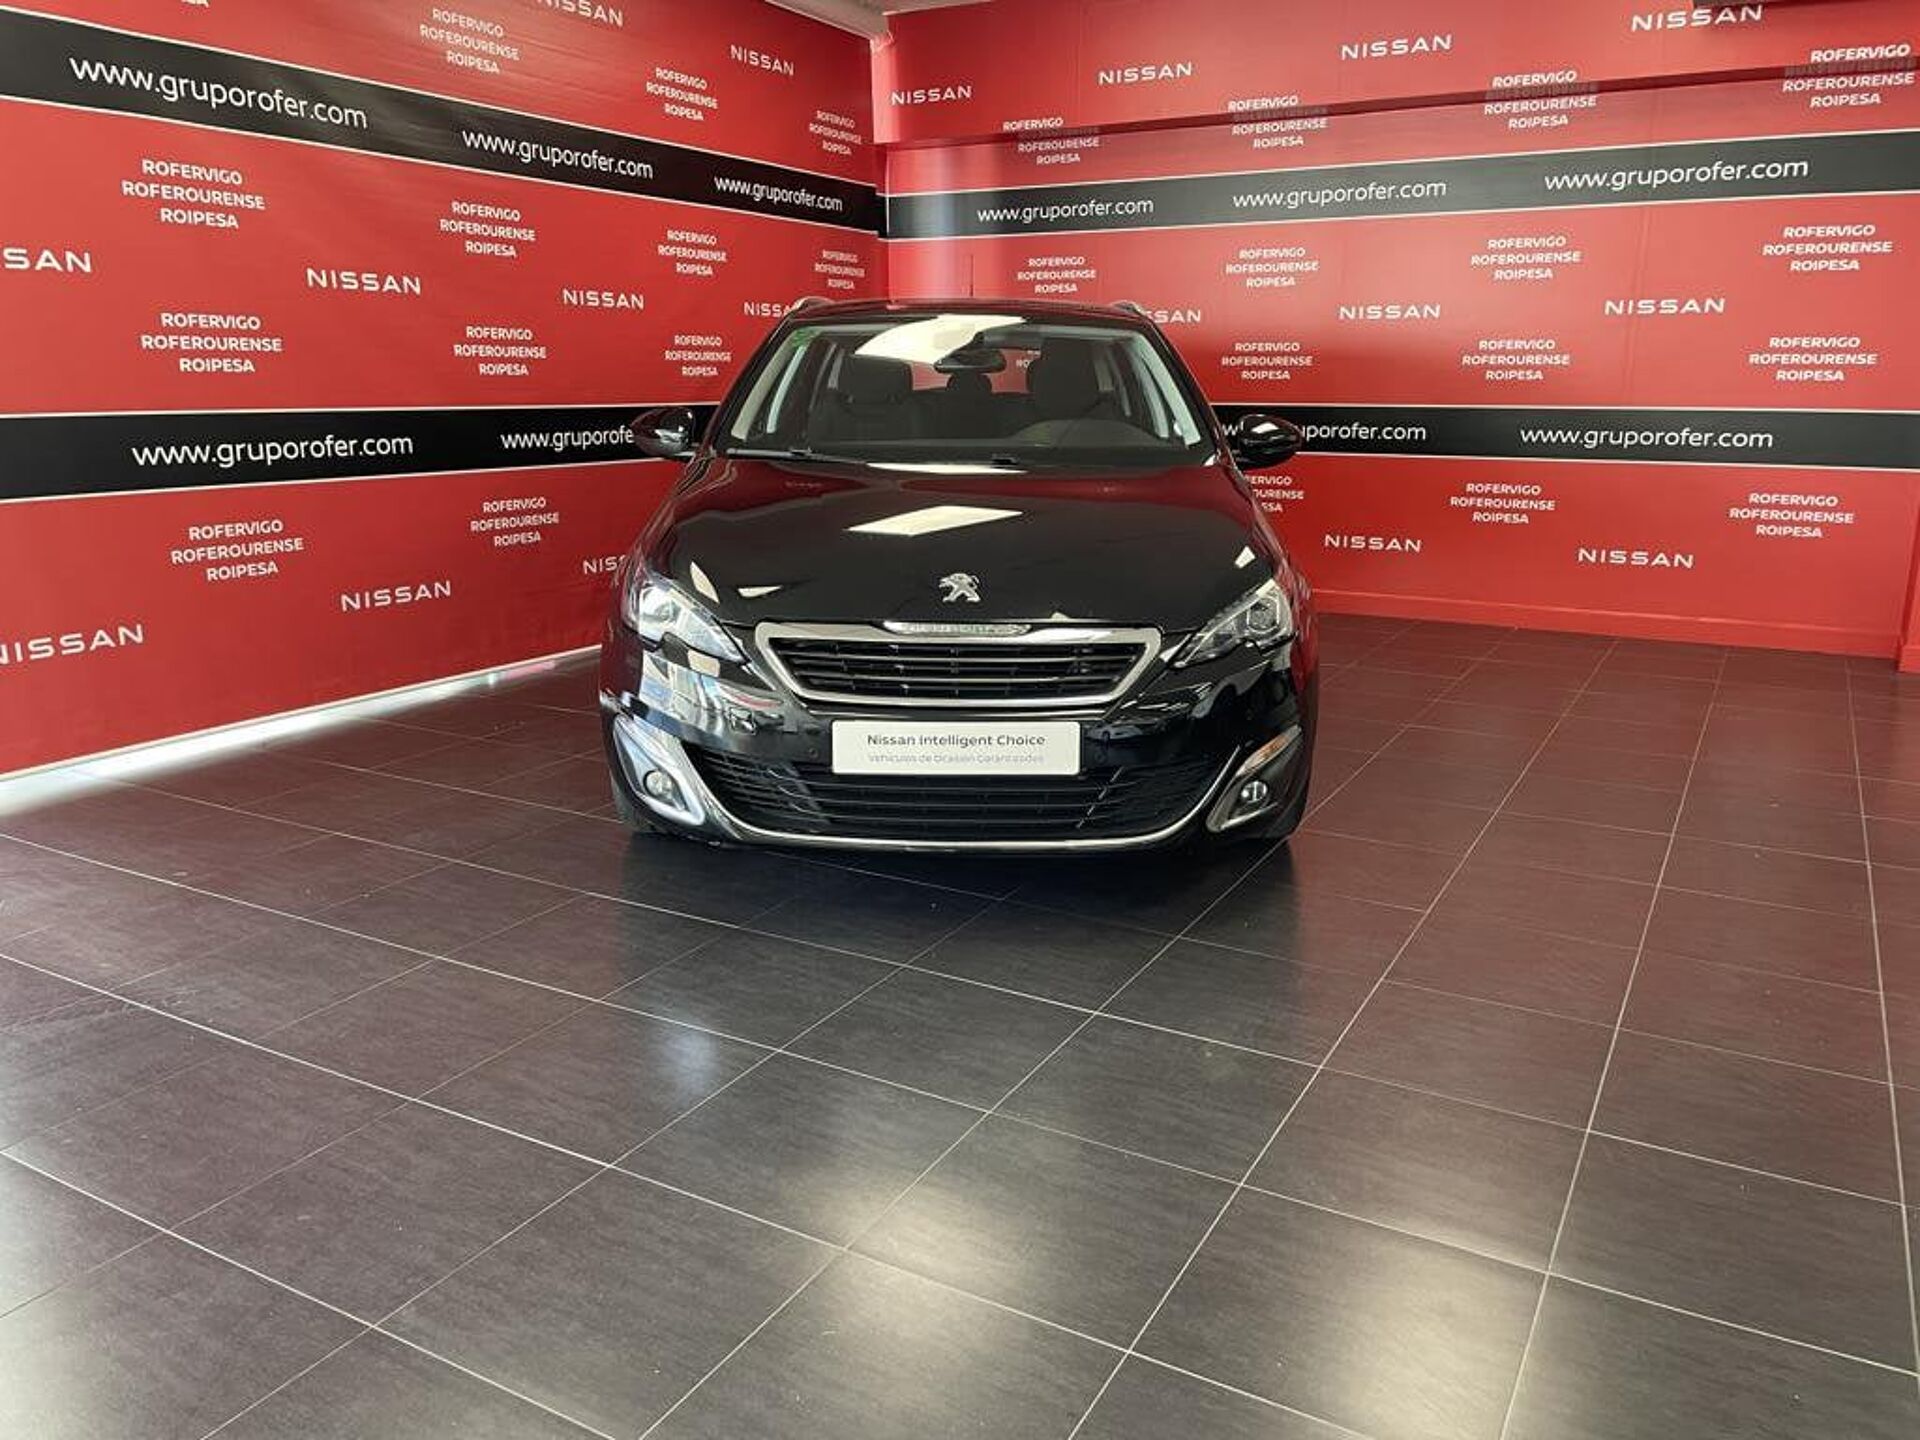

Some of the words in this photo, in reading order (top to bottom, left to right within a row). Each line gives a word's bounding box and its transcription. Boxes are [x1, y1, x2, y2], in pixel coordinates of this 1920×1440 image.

[433, 9, 503, 37] ROFERVIGO
[1631, 6, 1761, 32] NISSAN
[420, 24, 519, 60] ROFEROURENSE
[1342, 35, 1451, 60] NISSAN
[731, 45, 793, 75] NISSAN
[1811, 44, 1910, 62] ROFERVIGO
[447, 50, 499, 73] ROIPESA
[1100, 62, 1192, 84] NISSAN
[1493, 71, 1577, 88] ROFERVIGO
[1783, 72, 1914, 92] ROFEROURENSE
[70, 58, 367, 128] www.gruporofer.com
[891, 86, 971, 106] NISSAN
[1810, 93, 1880, 107] ROIPESA
[1228, 95, 1298, 112] ROFERVIGO
[1483, 95, 1598, 114] ROFEROURENSE
[1003, 117, 1063, 131] ROFERVIGO
[1232, 118, 1328, 135] ROFEROURENSE
[1509, 115, 1568, 128] ROIPESA
[1253, 136, 1303, 148] ROIPESA
[463, 130, 653, 179] www.gruporofer.com
[1037, 153, 1080, 164] ROIPESA
[142, 160, 242, 185] ROFERVIGO
[1544, 159, 1808, 191] www.gruporofer.com
[122, 180, 264, 209] ROFEROURENSE
[714, 176, 843, 211] www.gruporofer.com
[1233, 178, 1447, 210] www.gruporofer.com
[161, 208, 238, 228] ROIPESA
[452, 202, 520, 221] ROFERVIGO
[977, 198, 1154, 225] www.gruporofer.com
[440, 219, 535, 241] ROFEROURENSE
[1784, 225, 1875, 238] ROFERVIGO
[466, 241, 516, 257] ROIPESA
[1488, 236, 1566, 249] ROFERVIGO
[1763, 242, 1892, 255] ROFEROURENSE
[3, 247, 91, 273] SAN
[1240, 247, 1305, 259] ROFERVIGO
[1471, 251, 1580, 265] ROFEROURENSE
[1028, 257, 1085, 266] ROFERVIGO
[1226, 261, 1318, 273] ROFEROURENSE
[1791, 259, 1859, 271] ROIPESA
[307, 268, 420, 294] NISSAN
[1247, 276, 1295, 287] ROIPESA
[1494, 268, 1552, 280] ROIPESA
[1035, 283, 1077, 293] ROIPESA
[563, 289, 643, 309] NISSAN
[1605, 299, 1724, 314] NISSAN
[1340, 305, 1440, 319] NISSAN
[161, 313, 260, 330] ROFERVIGO
[466, 326, 532, 340] ROFERVIGO
[141, 335, 281, 351] ROFEROURENSE
[1235, 342, 1300, 351] ROFERVIGO
[1479, 339, 1555, 350] ROFERVIGO
[1770, 337, 1860, 348] ROFERVIGO
[454, 344, 546, 358] ROFEROURENSE
[1749, 354, 1877, 364] ROFEROURENSE
[180, 358, 255, 372] ROIPESA
[1222, 356, 1312, 366] ROFEROURENSE
[1463, 354, 1569, 365] ROFEROURENSE
[479, 364, 528, 375] ROIPESA
[1242, 370, 1290, 379] ROIPESA
[1486, 369, 1543, 380] ROIPESA
[1776, 370, 1844, 381] ROIPESA
[501, 425, 635, 452] www.gruporofe
[1520, 427, 1773, 449] www.gruporofer.com
[132, 434, 413, 468] www.gruporofer.com
[1466, 483, 1541, 495] ROFERVIGO
[483, 497, 546, 512] ROFERVIGO
[1451, 497, 1555, 510] ROFEROURENSE
[1749, 493, 1838, 506] ROFERVIGO
[471, 513, 558, 531] ROFEROURENSE
[1473, 512, 1528, 523] ROIPESA
[1730, 508, 1853, 523] ROFEROURENSE
[189, 520, 283, 540] ROFERVIGO
[1756, 525, 1822, 537] ROIPESA
[494, 531, 541, 546] ROIPESA
[1325, 535, 1421, 552] NISSAN
[171, 538, 303, 564] ROFEROURENSE
[1579, 549, 1693, 568] NISSAN
[207, 561, 278, 581] ROIPESA
[582, 555, 625, 574] NIS
[341, 581, 450, 611] NISSAN
[867, 734, 916, 746] Nissan
[919, 734, 992, 749] Intelligent
[996, 734, 1046, 746] Choice
